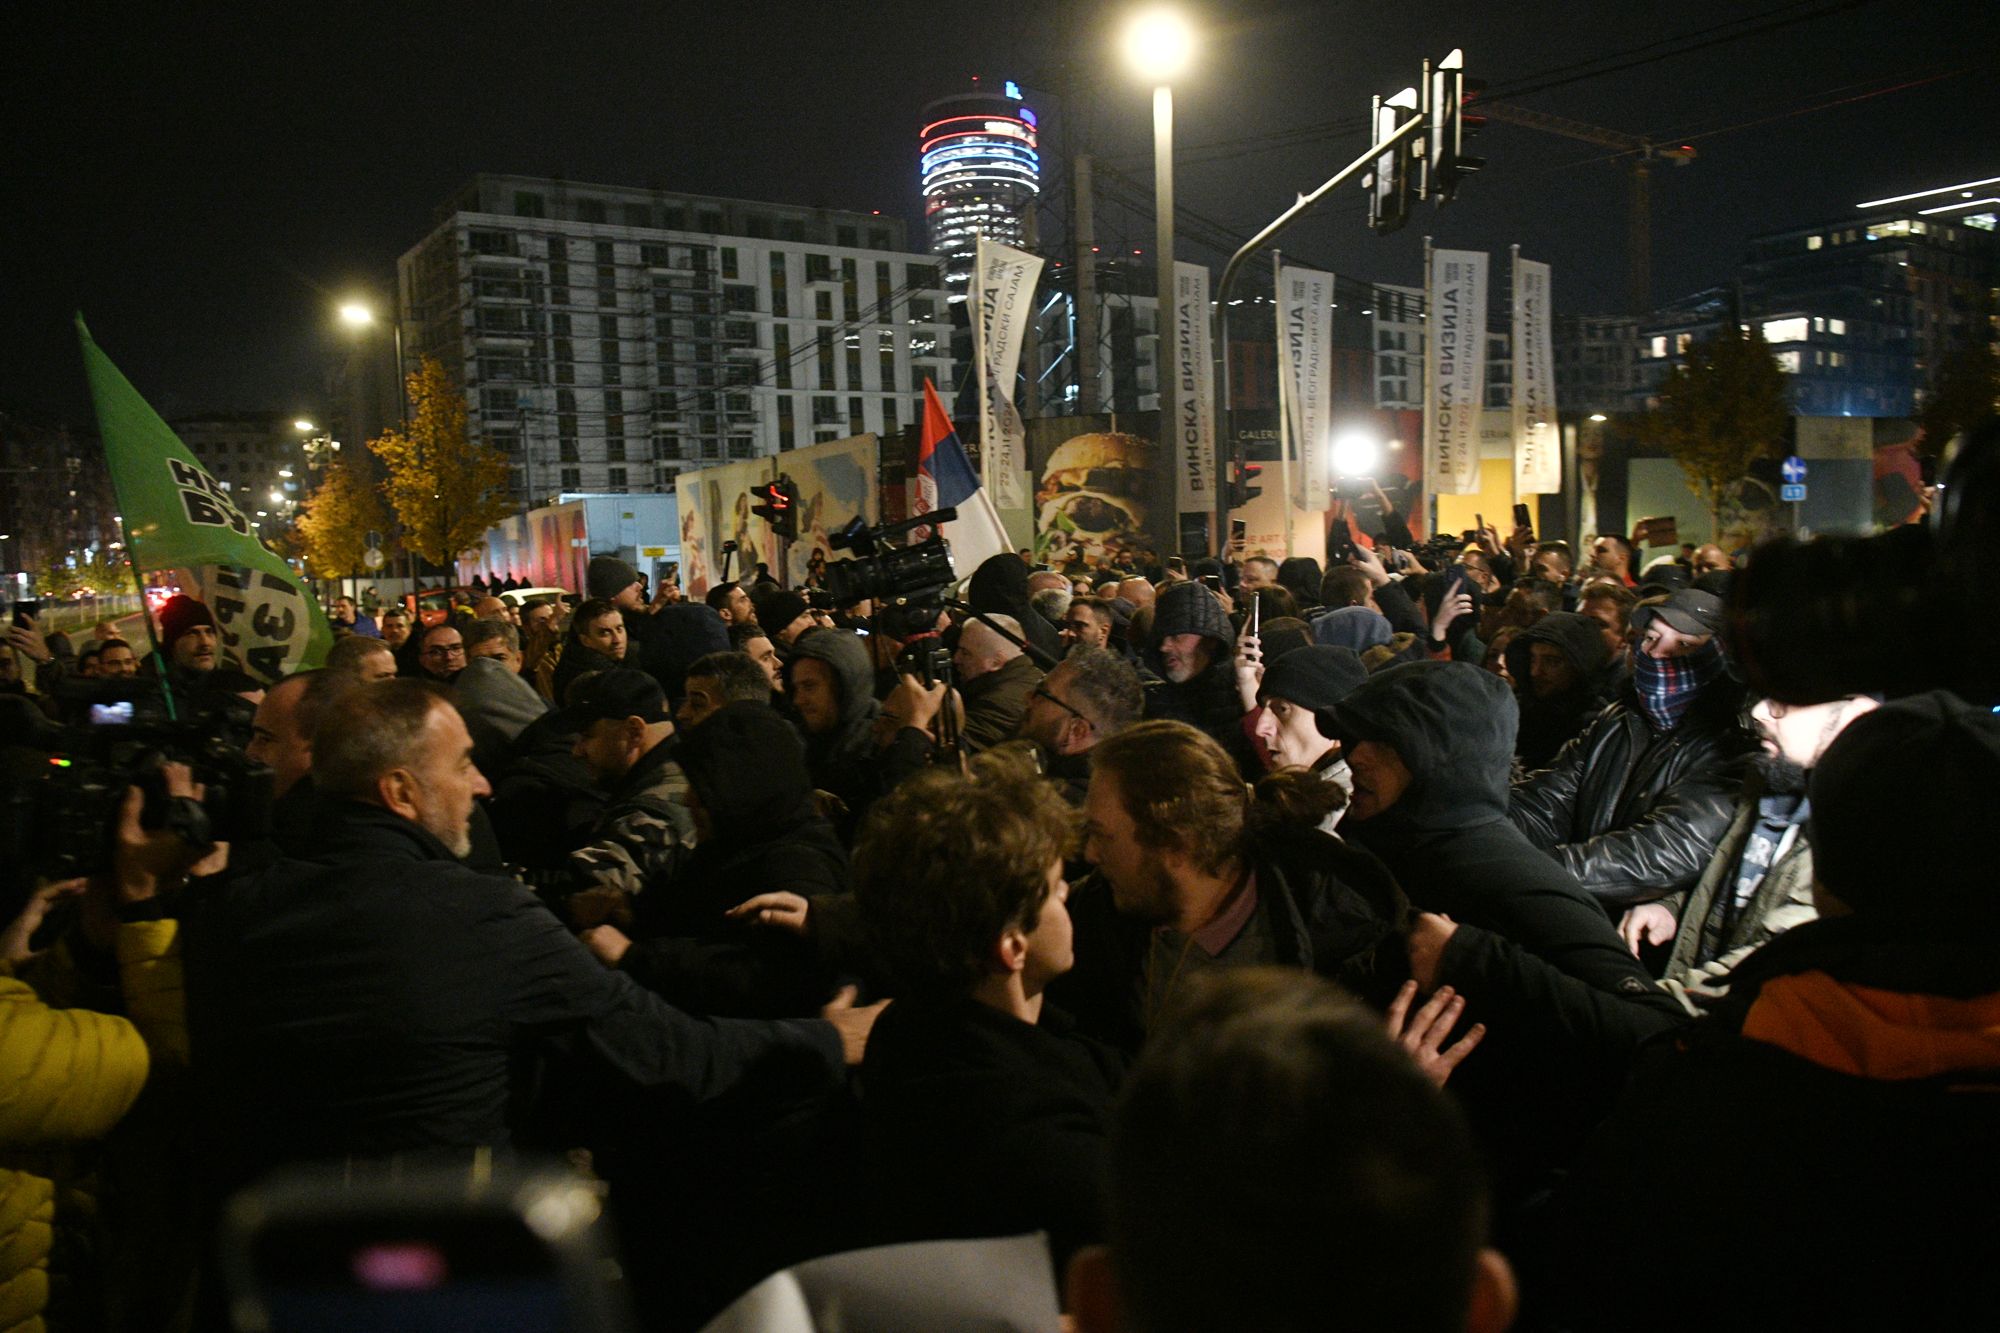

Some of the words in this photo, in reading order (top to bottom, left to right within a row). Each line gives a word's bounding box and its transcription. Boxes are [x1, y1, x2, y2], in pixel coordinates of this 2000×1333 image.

[1003, 265, 1024, 310] САЈАМ
[1439, 288, 1459, 375] ВИЗИЈА
[1180, 303, 1194, 391] ВИЗИЈА
[1289, 306, 1305, 394] ИЗИЈА
[1184, 399, 1205, 491] ВИНСКА
[1438, 383, 1454, 475] ВИНСКА
